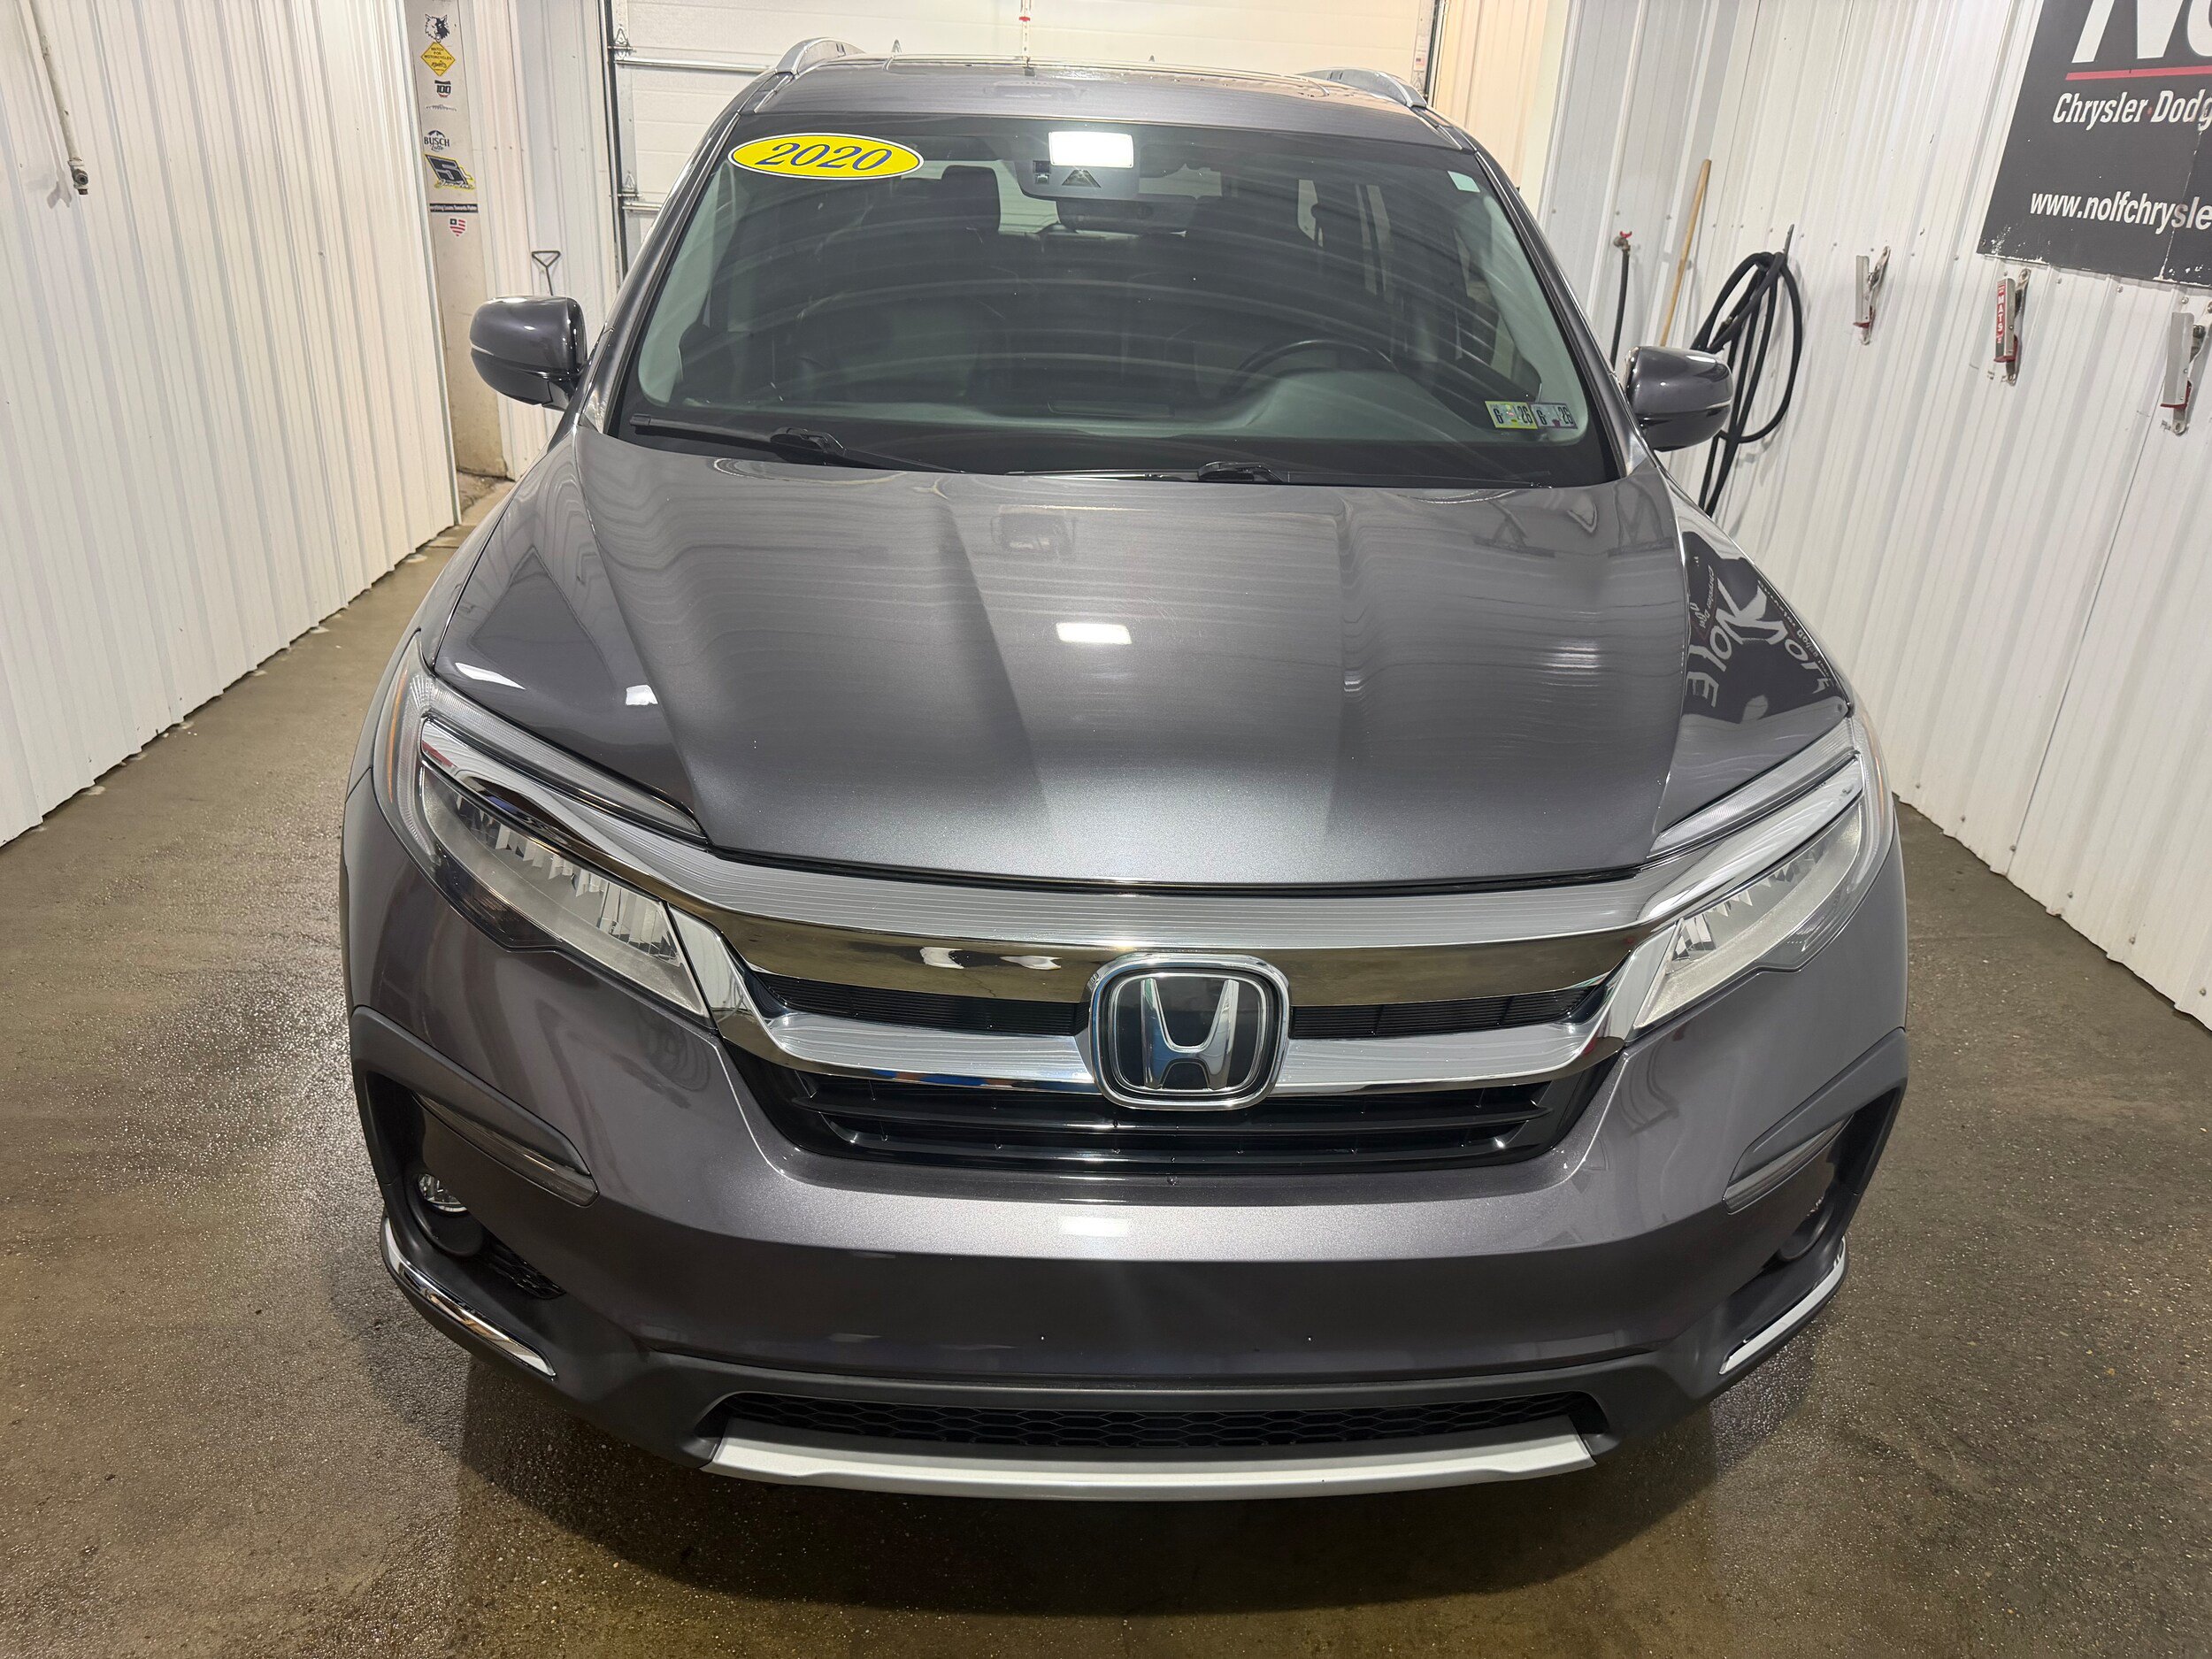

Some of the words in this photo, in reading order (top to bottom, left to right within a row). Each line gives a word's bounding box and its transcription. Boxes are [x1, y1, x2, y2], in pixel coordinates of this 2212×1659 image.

[2052, 91, 2150, 131] Chrysler
[424, 136, 450, 147] BUSCH
[755, 142, 892, 171] 2020
[2030, 190, 2212, 235] www.nolfchrysle
[1493, 408, 1504, 424] 6
[1517, 406, 1533, 424] 26
[1536, 410, 1548, 426] 6
[1557, 407, 1574, 424] 26
